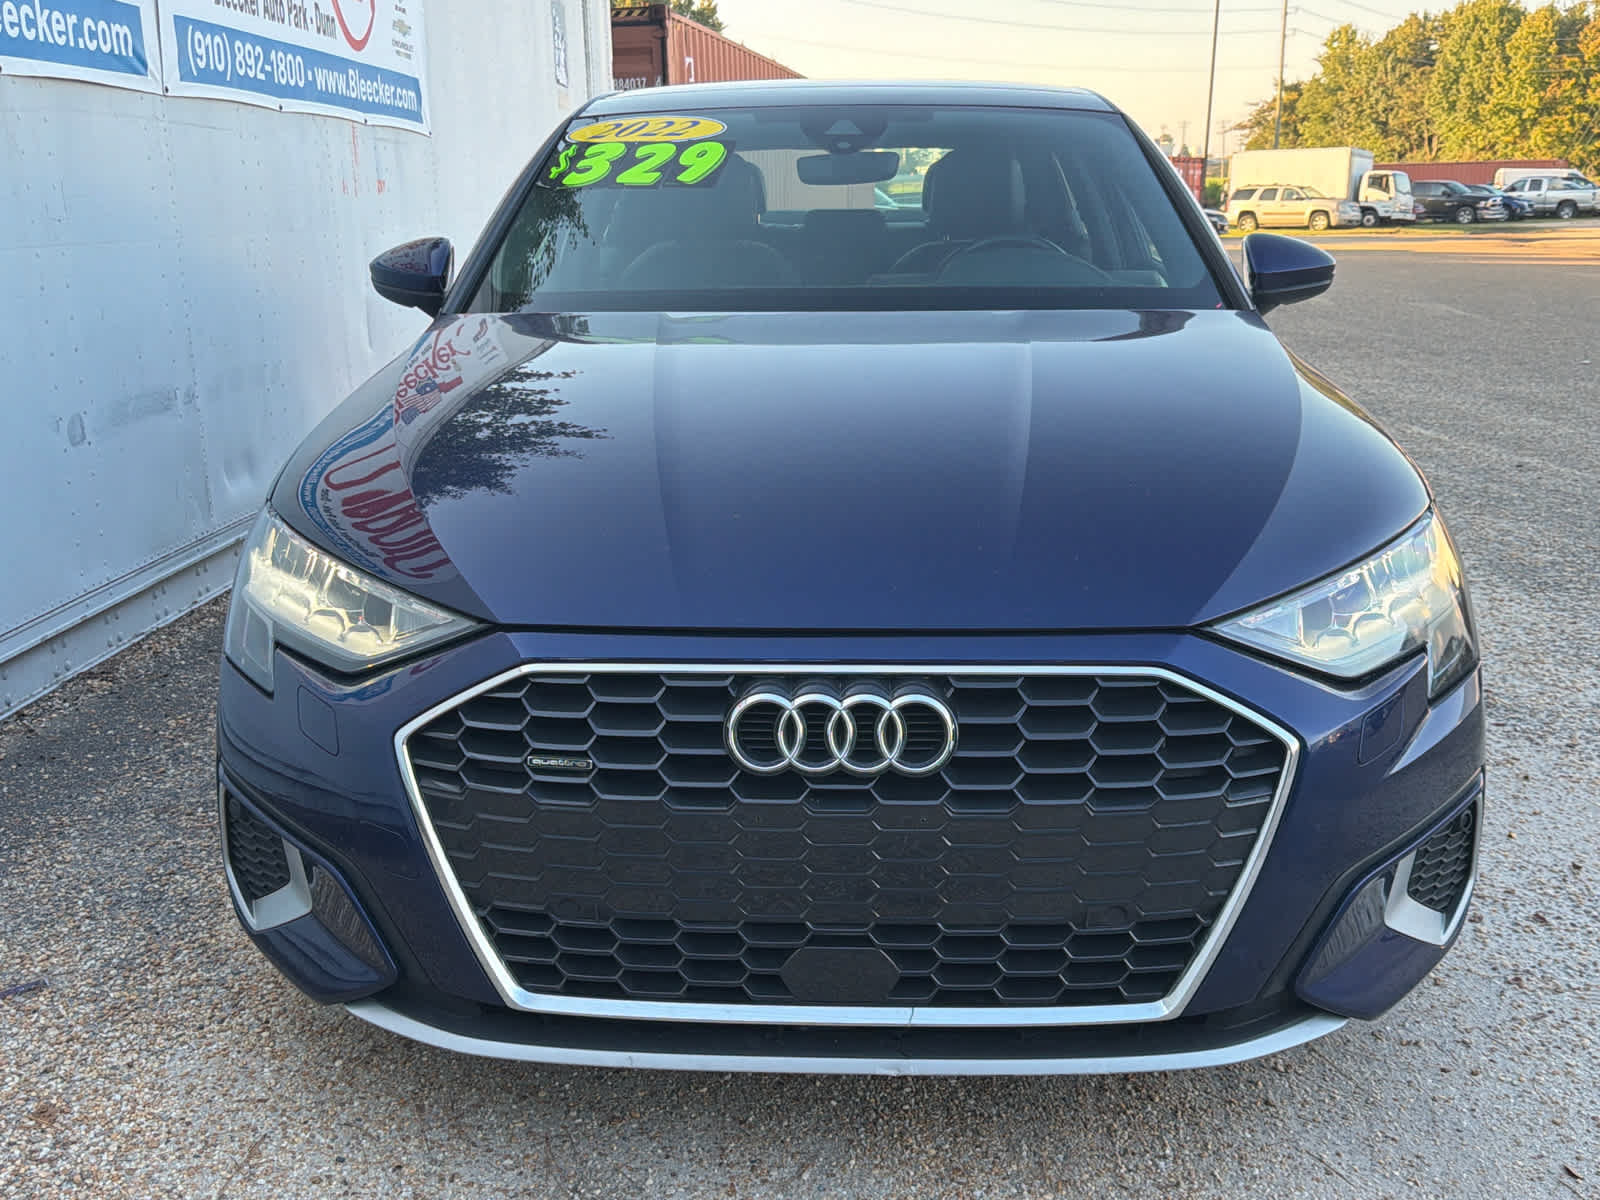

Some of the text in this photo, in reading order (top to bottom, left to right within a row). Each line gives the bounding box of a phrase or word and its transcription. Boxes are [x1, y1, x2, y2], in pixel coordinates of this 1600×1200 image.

[0, 0, 133, 57] ecker.com
[263, 0, 285, 24] Auto
[287, 0, 309, 32] Park
[314, 2, 337, 40] Dunn
[187, 25, 417, 112] (910) 892-1800 www.Bleecker.com
[588, 120, 701, 140] 2022
[549, 141, 727, 188] $329
[531, 758, 587, 768] quattro
